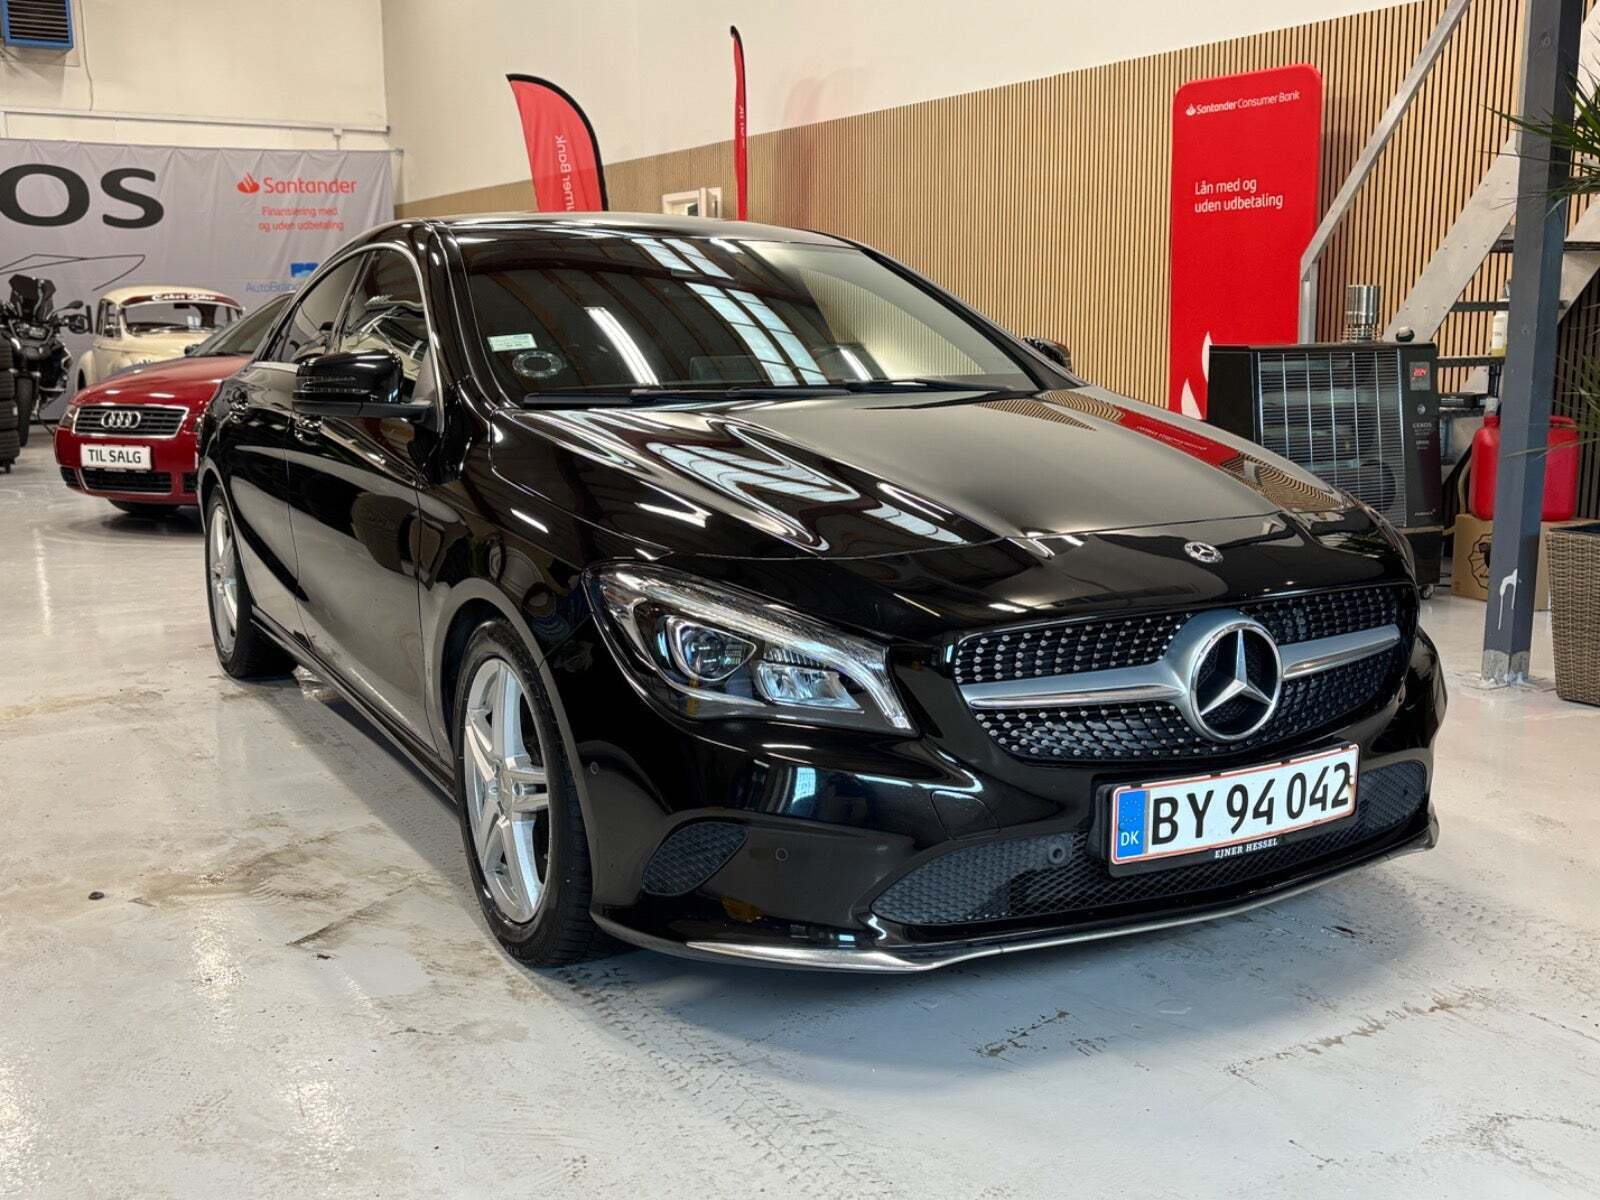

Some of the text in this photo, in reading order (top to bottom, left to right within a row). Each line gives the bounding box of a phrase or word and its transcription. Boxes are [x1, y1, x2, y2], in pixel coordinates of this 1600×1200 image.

[1196, 89, 1301, 115] Santander Consumer Bank
[263, 176, 358, 194] Santander
[1194, 177, 1258, 196] Lån med og
[0, 163, 165, 229] OS
[1194, 192, 1284, 214] uden udbetaling
[261, 206, 339, 218] Finansiering med
[258, 220, 345, 233] og uden udbetaling
[88, 448, 142, 464] TIL SALG
[1151, 761, 1351, 846] BY 94 042
[1120, 830, 1140, 847] DK
[1214, 837, 1279, 860] EJNER HESSEL
